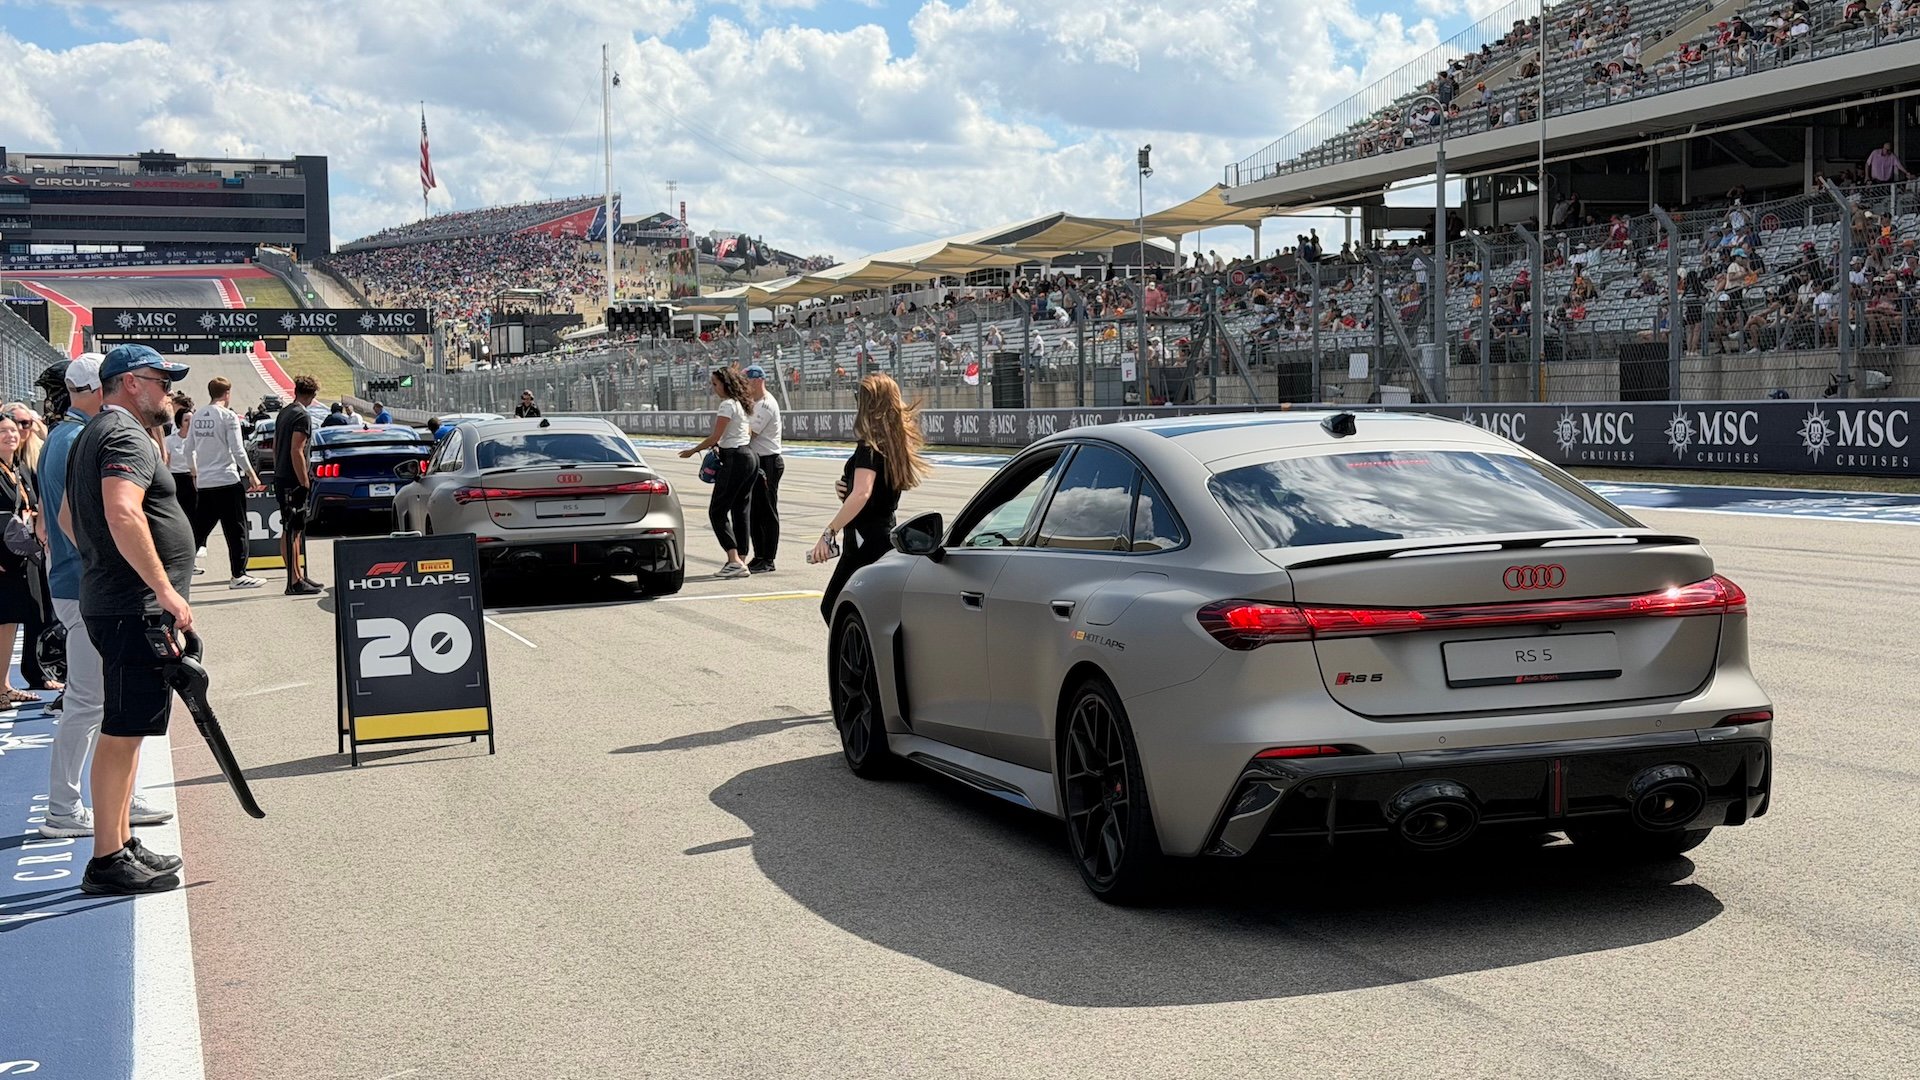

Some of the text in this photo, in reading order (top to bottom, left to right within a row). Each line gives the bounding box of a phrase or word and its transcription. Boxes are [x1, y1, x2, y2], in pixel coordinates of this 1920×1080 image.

[35, 177, 99, 186] CIRCUIT
[136, 313, 177, 326] MSC
[219, 313, 258, 326] MSC
[300, 313, 337, 326] MSC
[378, 313, 415, 326] MSC
[174, 344, 189, 352] LAP
[1126, 370, 1132, 378] F
[928, 415, 944, 432] MSC
[962, 415, 979, 433] MSC
[998, 414, 1016, 434] MSC
[1037, 415, 1057, 434] MSC
[1481, 412, 1526, 442] MSC
[1581, 412, 1634, 444] MSC
[1697, 410, 1759, 446] MSC
[1836, 410, 1909, 448] MSC
[1582, 451, 1634, 461] CRUISES
[1698, 452, 1759, 464] CRUISES
[1837, 454, 1909, 467] CRUISES
[349, 572, 471, 590] HOT LAPS
[356, 612, 473, 678] 20
[1100, 636, 1126, 651] LAPS
[1515, 649, 1552, 662] RS 5
[1344, 673, 1383, 683] RS 5
